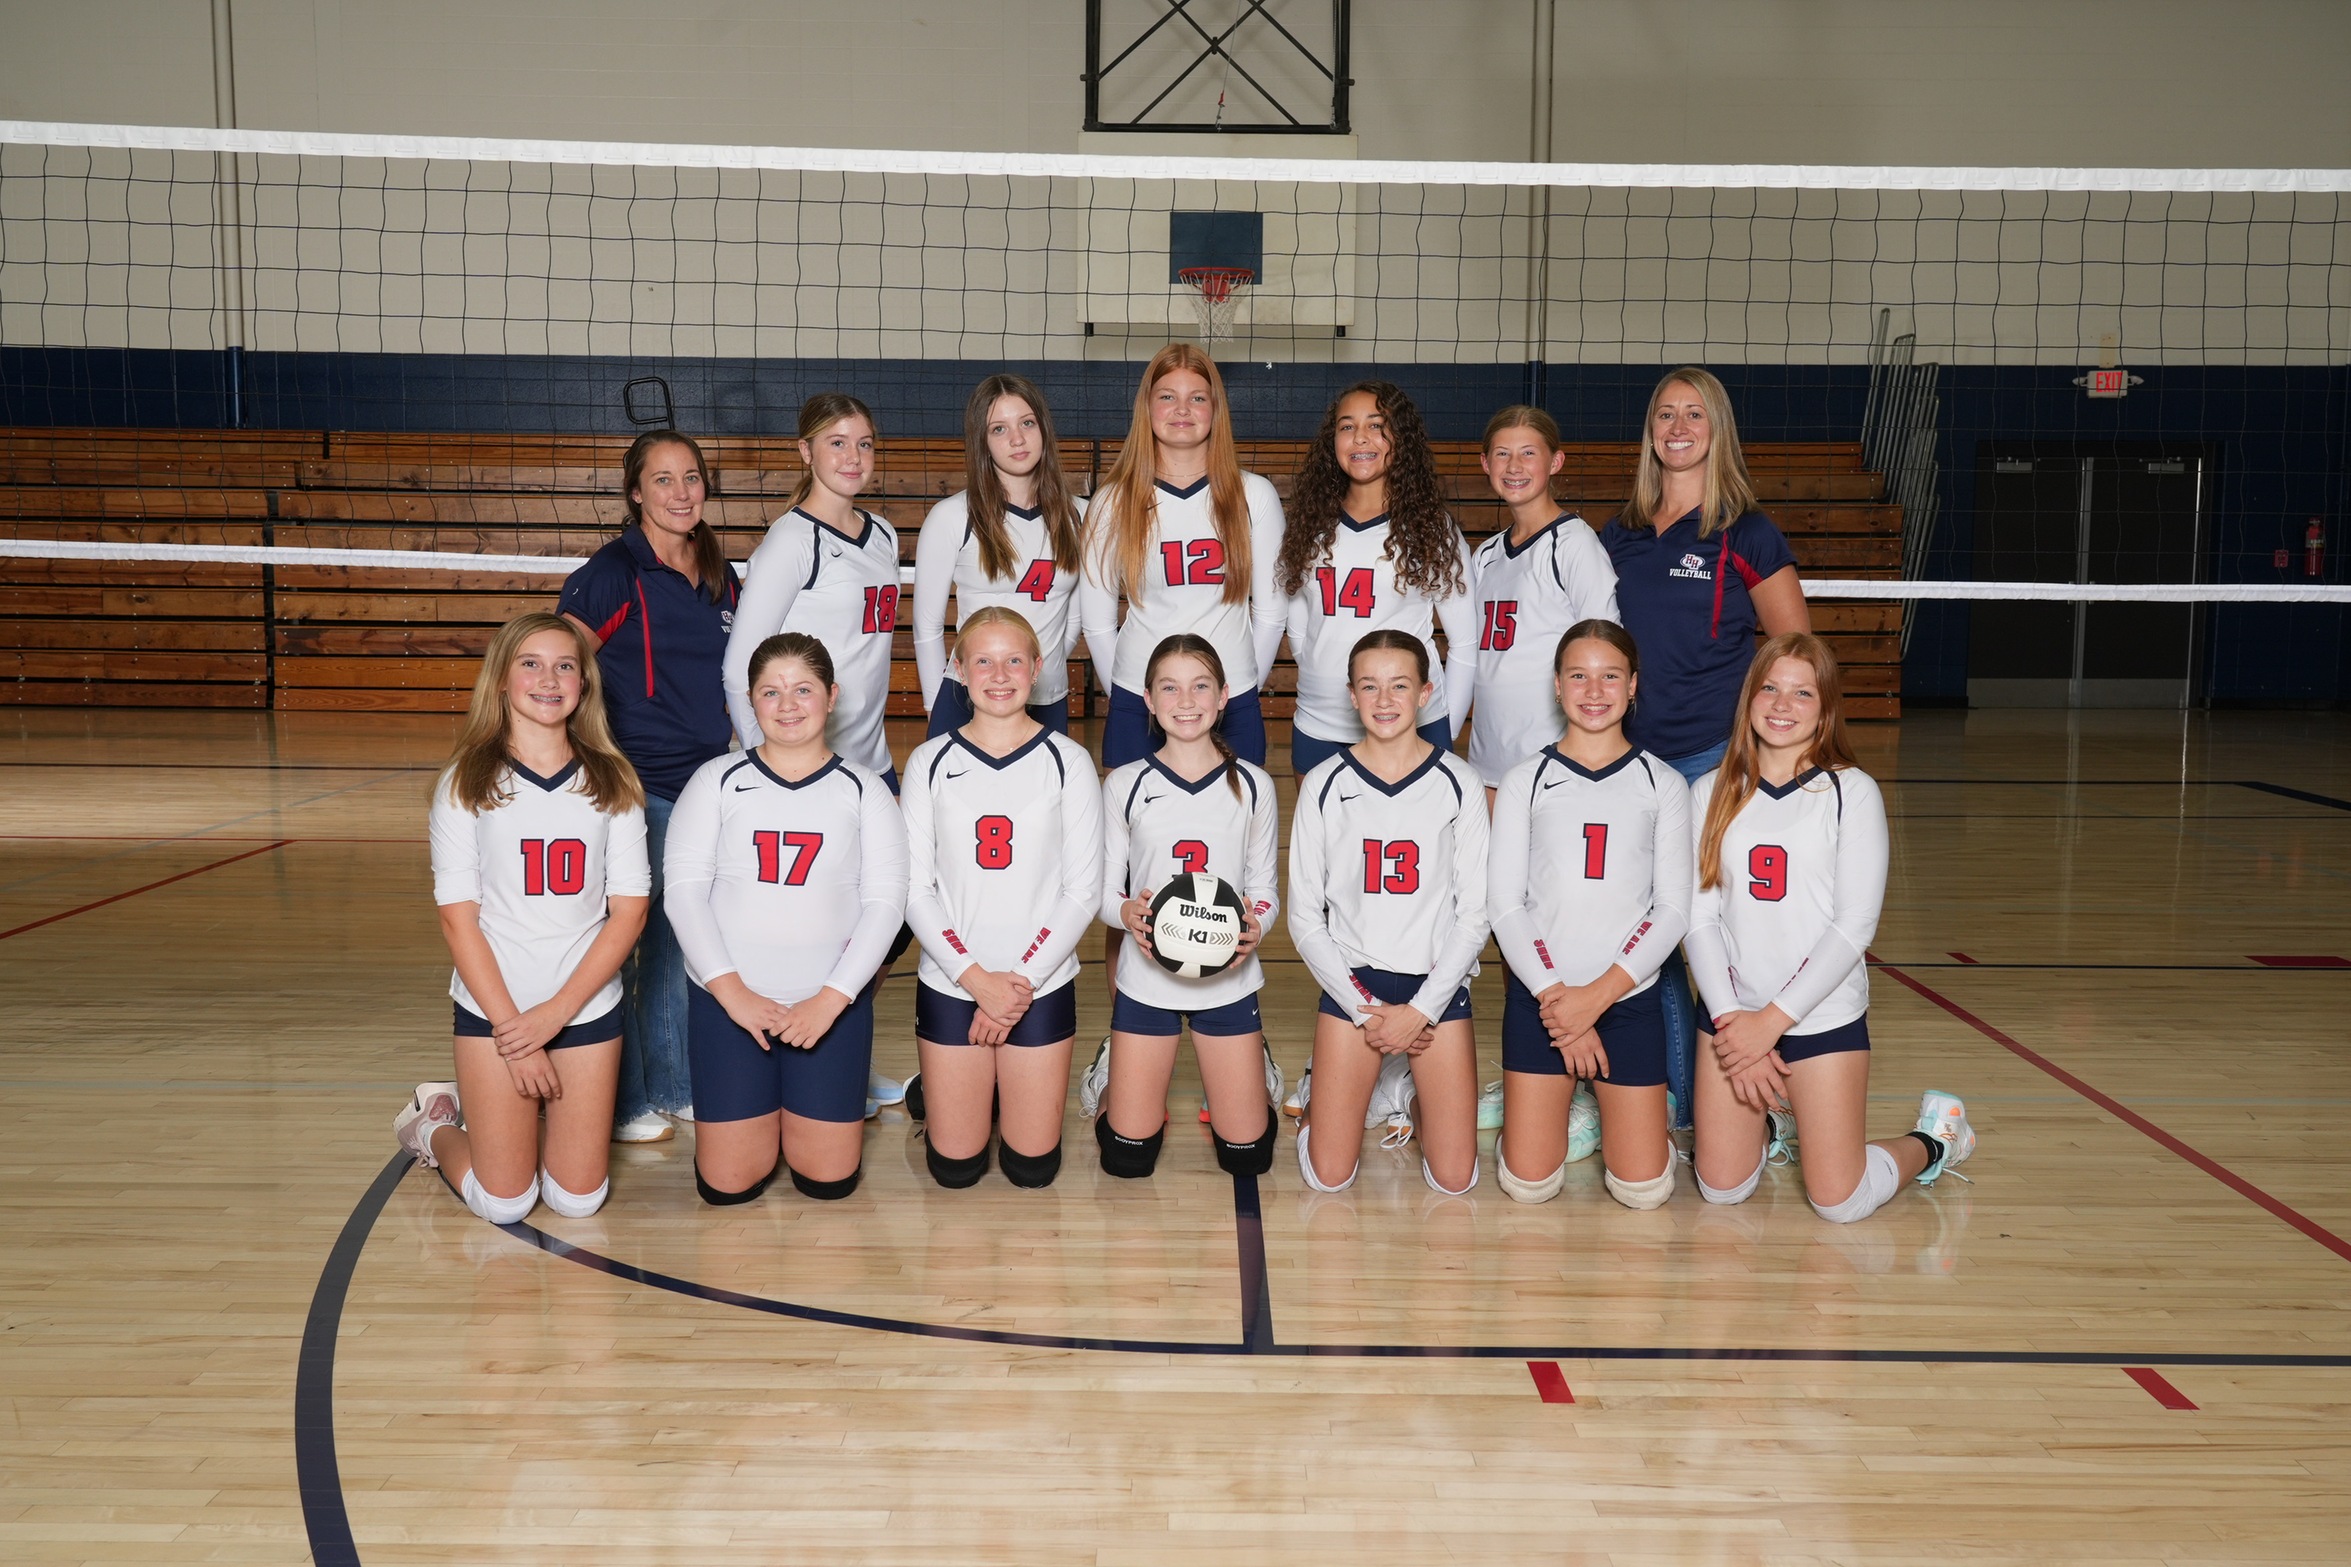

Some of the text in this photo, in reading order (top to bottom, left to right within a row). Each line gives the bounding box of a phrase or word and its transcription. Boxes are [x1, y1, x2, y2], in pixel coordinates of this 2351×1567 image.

[2096, 371, 2123, 392] EXIT
[1016, 558, 1056, 603] 4
[1160, 537, 1227, 587] 12
[1669, 568, 1711, 580] VOLLEYBALL
[862, 584, 899, 635] 18
[1315, 566, 1377, 619] 14
[1479, 600, 1519, 652] 15
[520, 838, 587, 897] 10
[753, 829, 824, 887] 17
[975, 814, 1014, 871] 8
[1362, 838, 1421, 895] 13
[1583, 823, 1609, 880] 1
[1748, 843, 1789, 903] 9
[1179, 903, 1228, 924] Wilson
[1188, 928, 1208, 945] K1
